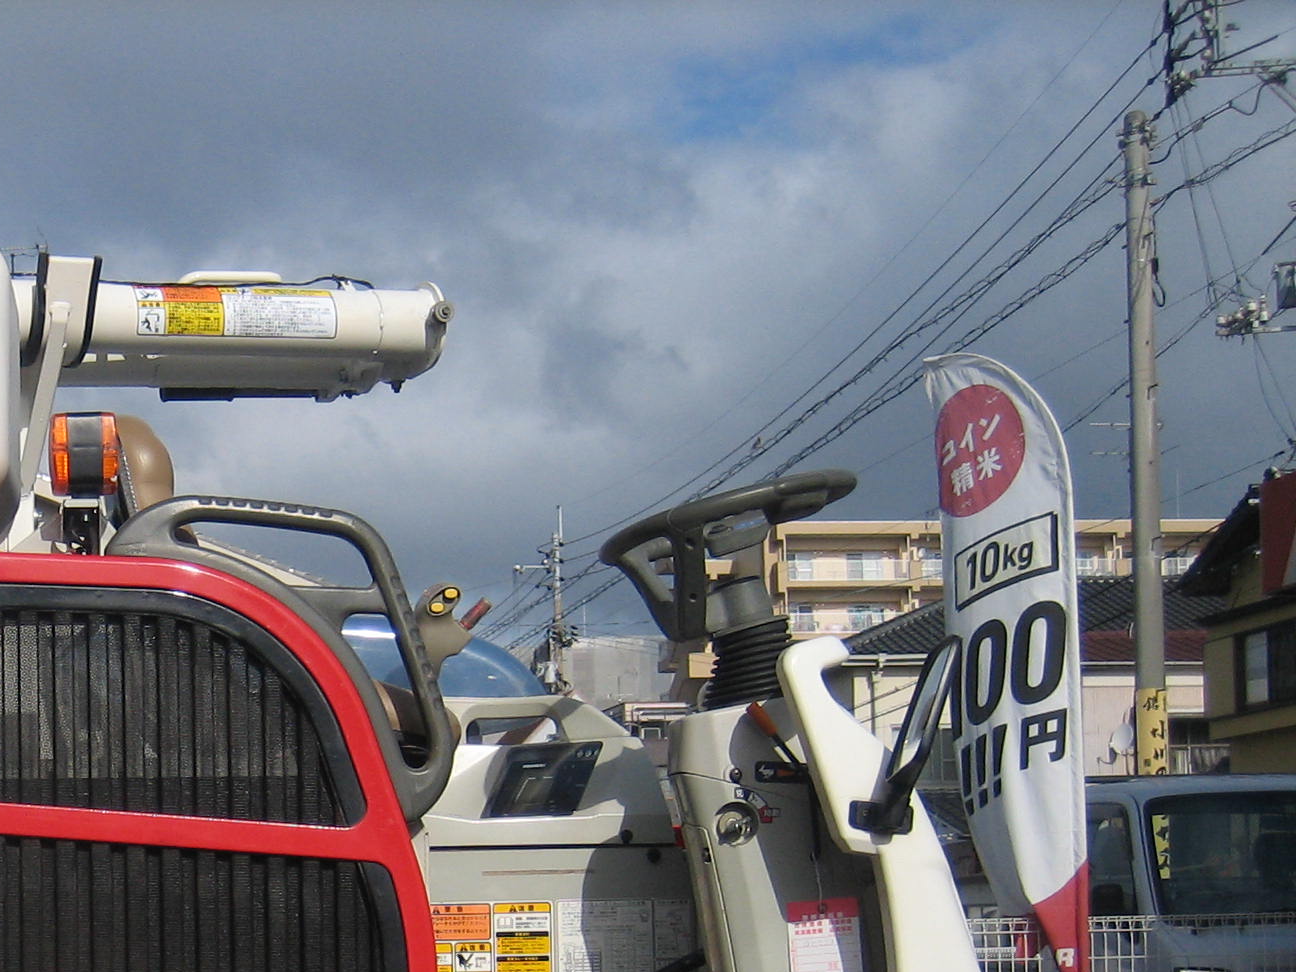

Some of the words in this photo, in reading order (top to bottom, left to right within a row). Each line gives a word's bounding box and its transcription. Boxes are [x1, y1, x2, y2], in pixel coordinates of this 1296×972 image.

[942, 414, 1001, 466] コイン
[950, 447, 1003, 496] 精米
[966, 540, 1034, 591] 10kg
[1019, 709, 1067, 770] 円
